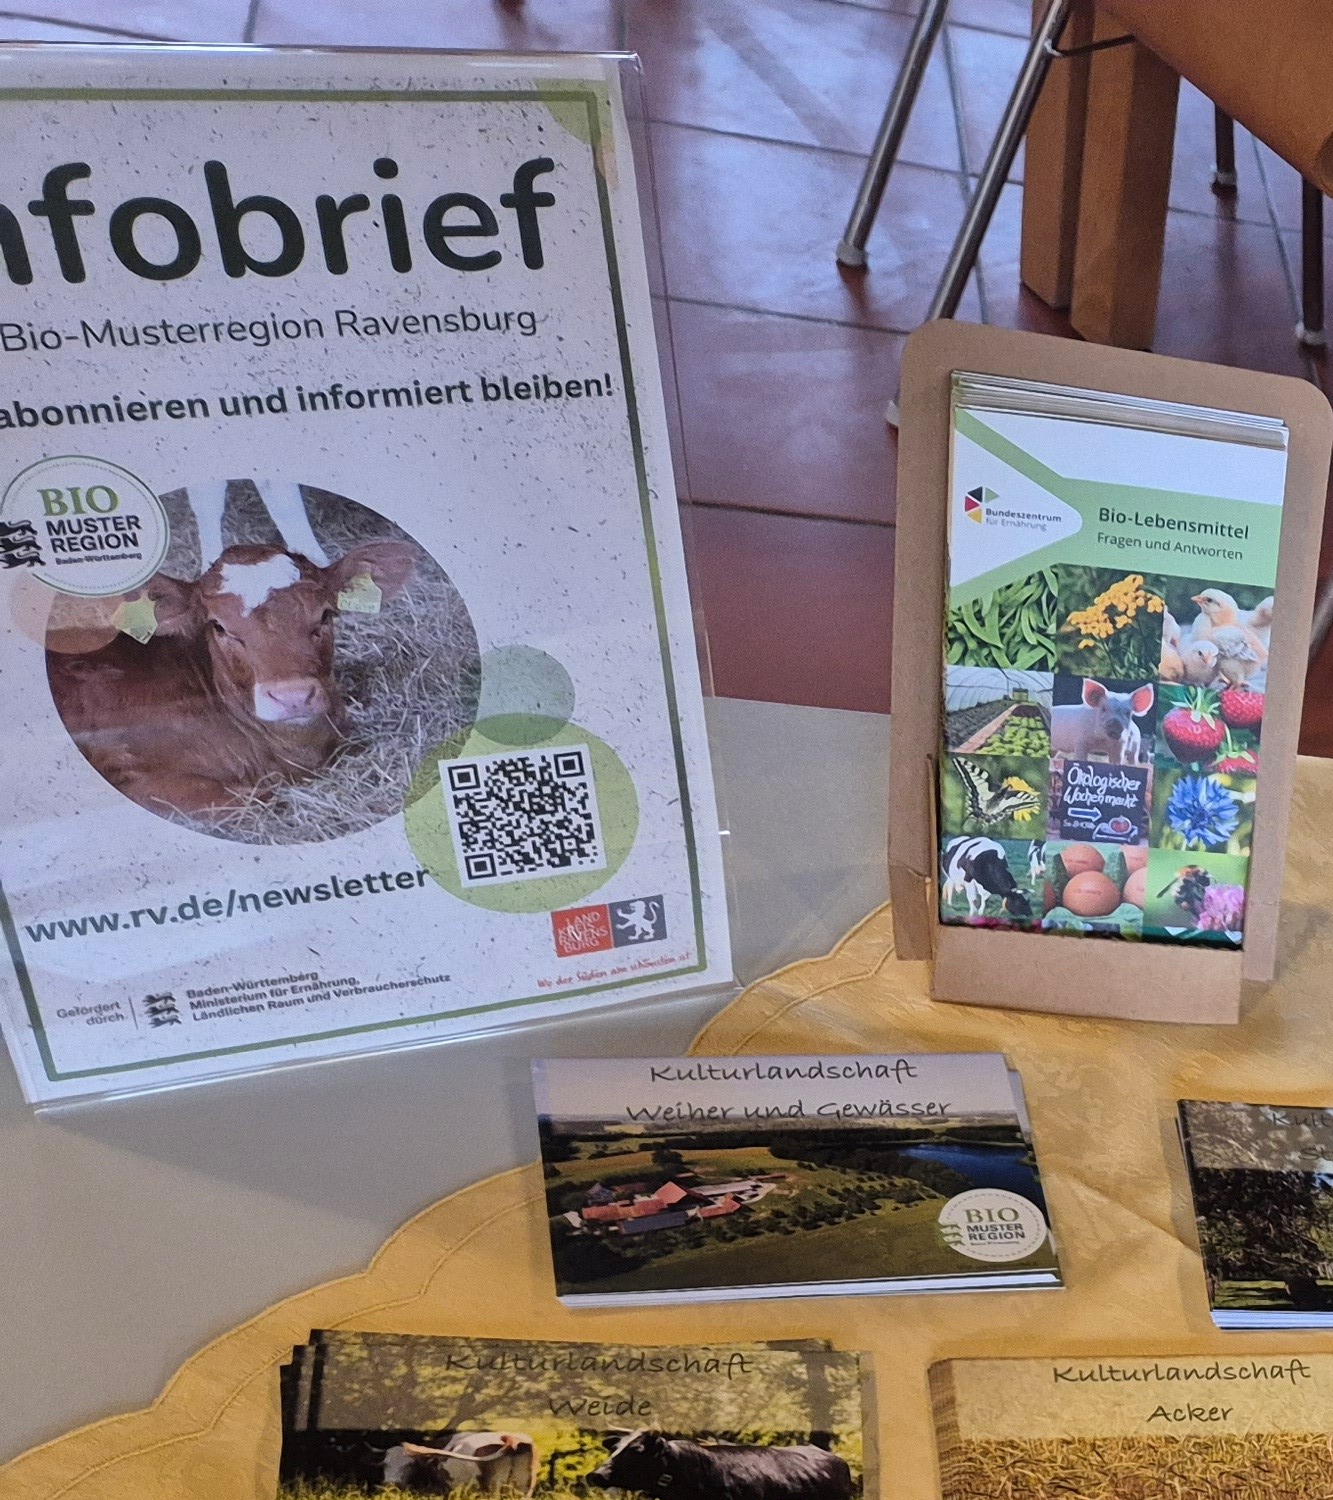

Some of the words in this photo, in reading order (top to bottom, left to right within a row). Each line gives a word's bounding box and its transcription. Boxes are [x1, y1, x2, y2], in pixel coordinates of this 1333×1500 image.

[1, 312, 323, 352] Bio-Musterregion
[336, 304, 538, 338] Ravensburg
[220, 386, 288, 418] und
[297, 378, 470, 412] informiert
[480, 373, 613, 405] bleiben!
[37, 485, 119, 517] BIO
[46, 515, 142, 537] MUSTER
[986, 507, 1062, 522] Bundeszentrum
[1098, 507, 1250, 540] Bio-Lebensmittel
[50, 532, 139, 553] REGION
[1097, 532, 1142, 549] Fragen
[1145, 539, 1170, 551] und
[1173, 542, 1243, 560] Antworten
[25, 865, 431, 945] www.rv.de/newsletter
[186, 972, 319, 998] Baden-Württemberg
[649, 1058, 918, 1083] Kulturlandschaft
[626, 1101, 735, 1121] Weiher
[744, 1099, 805, 1119] und
[817, 1099, 951, 1118] Gewässer
[444, 1351, 754, 1379] Kulturlandschaft
[1052, 1360, 1312, 1384] Kulturlandschaft
[547, 1396, 652, 1418] Weide
[1146, 1403, 1234, 1423] Acker
